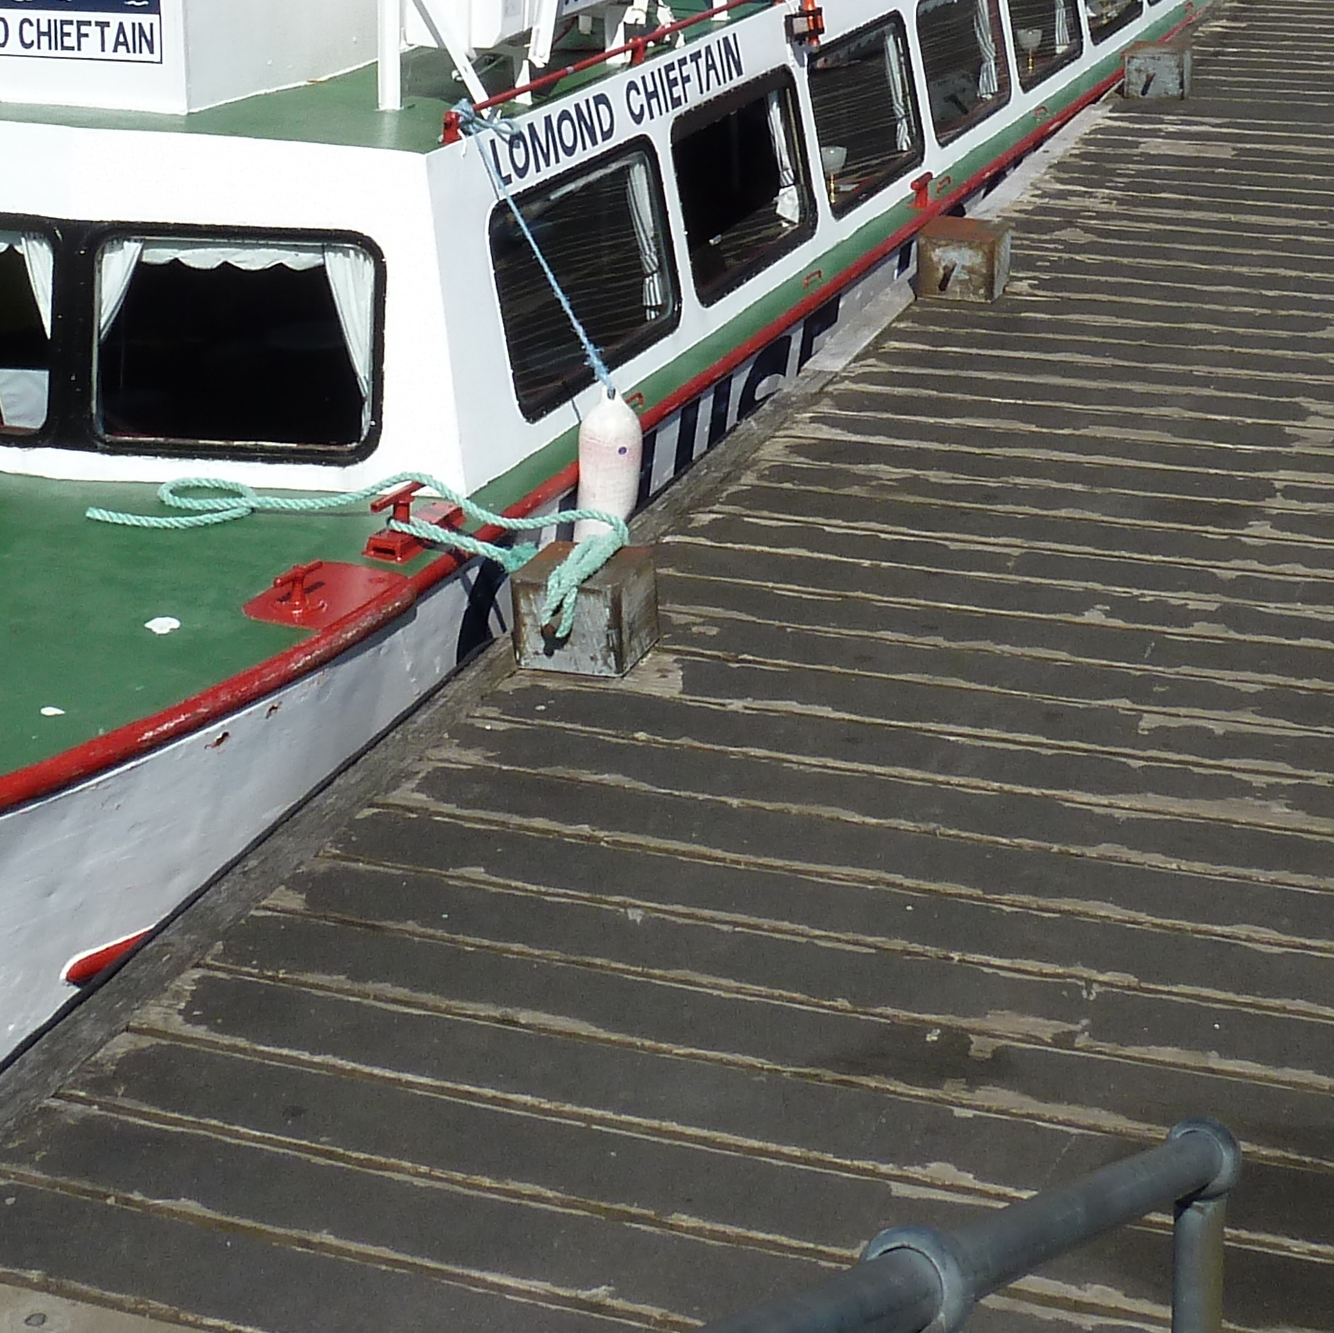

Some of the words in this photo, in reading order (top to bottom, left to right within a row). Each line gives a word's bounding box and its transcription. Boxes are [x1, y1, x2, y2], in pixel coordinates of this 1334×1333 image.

[19, 18, 155, 54] CHIEFTAIN
[490, 92, 616, 186] LOMOND
[625, 32, 745, 126] CHIEFTAIN
